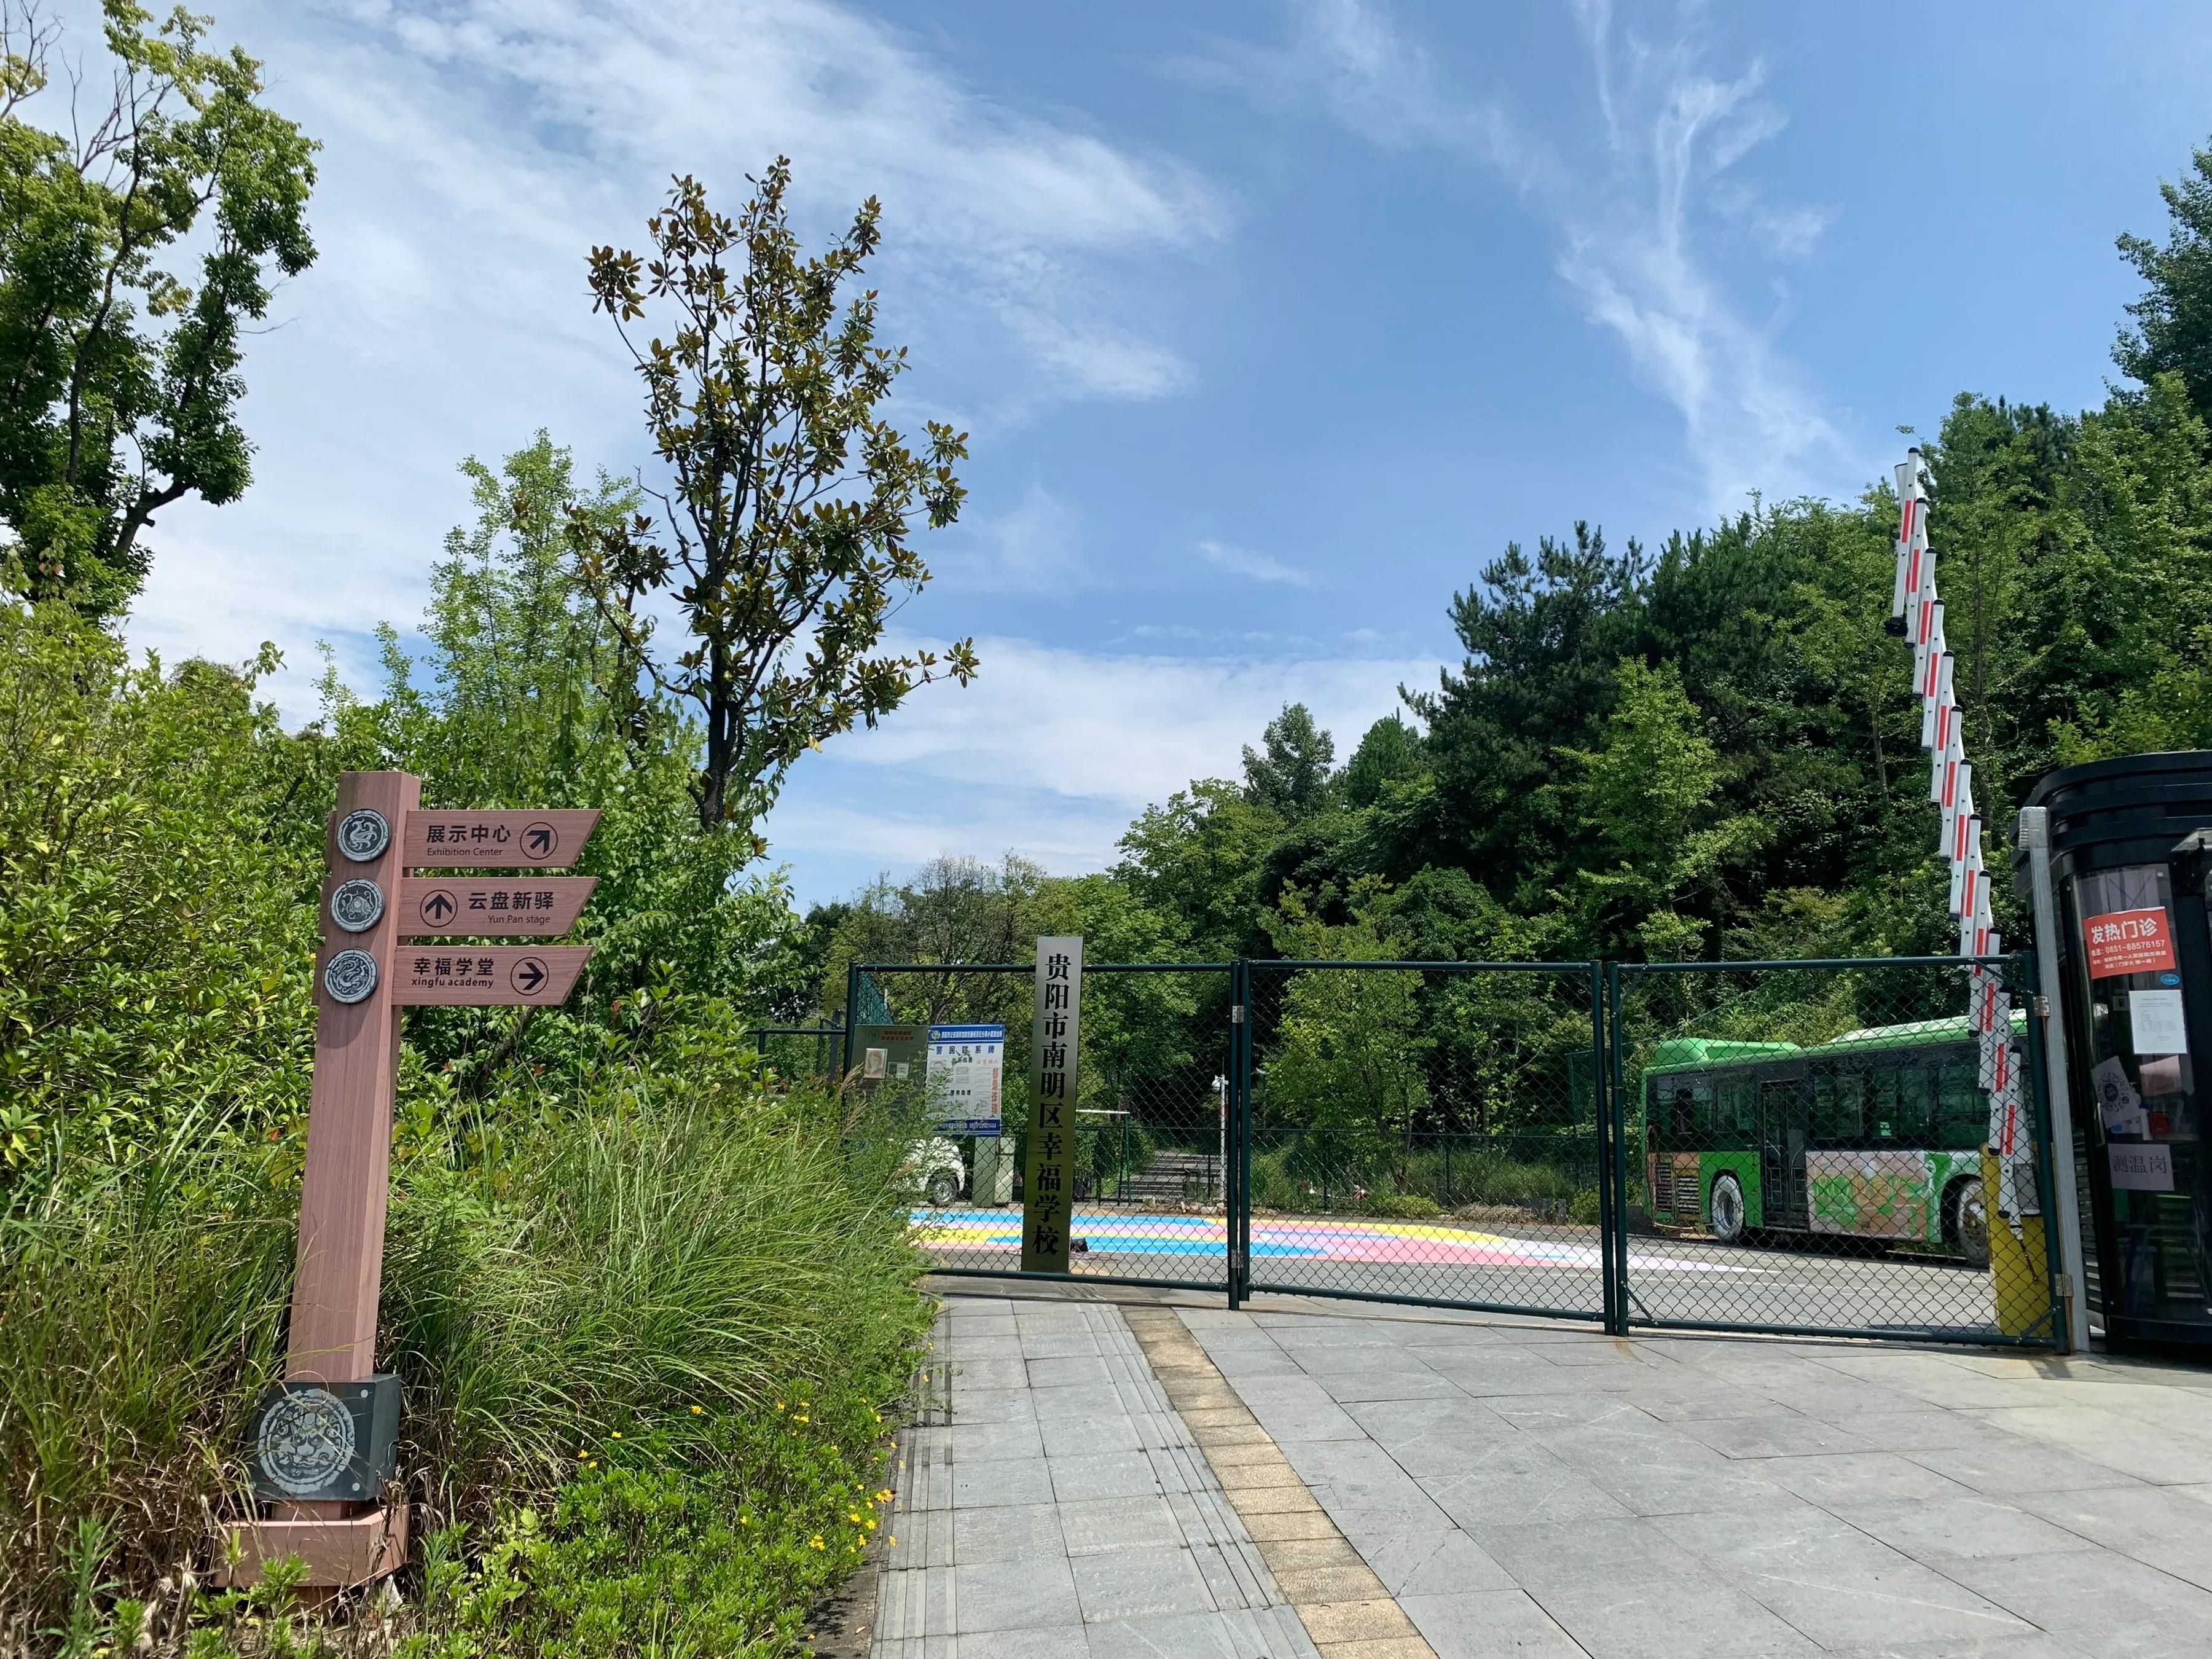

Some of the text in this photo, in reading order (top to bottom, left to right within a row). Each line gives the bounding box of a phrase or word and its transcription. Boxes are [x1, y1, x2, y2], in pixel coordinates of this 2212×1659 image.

[426, 824, 511, 843] 展示中心
[427, 847, 503, 856] Exhibition Center
[468, 891, 554, 910] 云盘新驿
[488, 915, 551, 925] Yun Pan stage
[2091, 917, 2158, 944] 发热门诊
[414, 957, 494, 976] 幸福学堂
[412, 977, 493, 989] xingfu academy
[936, 1045, 995, 1055] 警民联系牌
[1032, 953, 1072, 1256] 贵阳市南明区幸福学校
[2112, 1155, 2167, 1174] 测温岗
